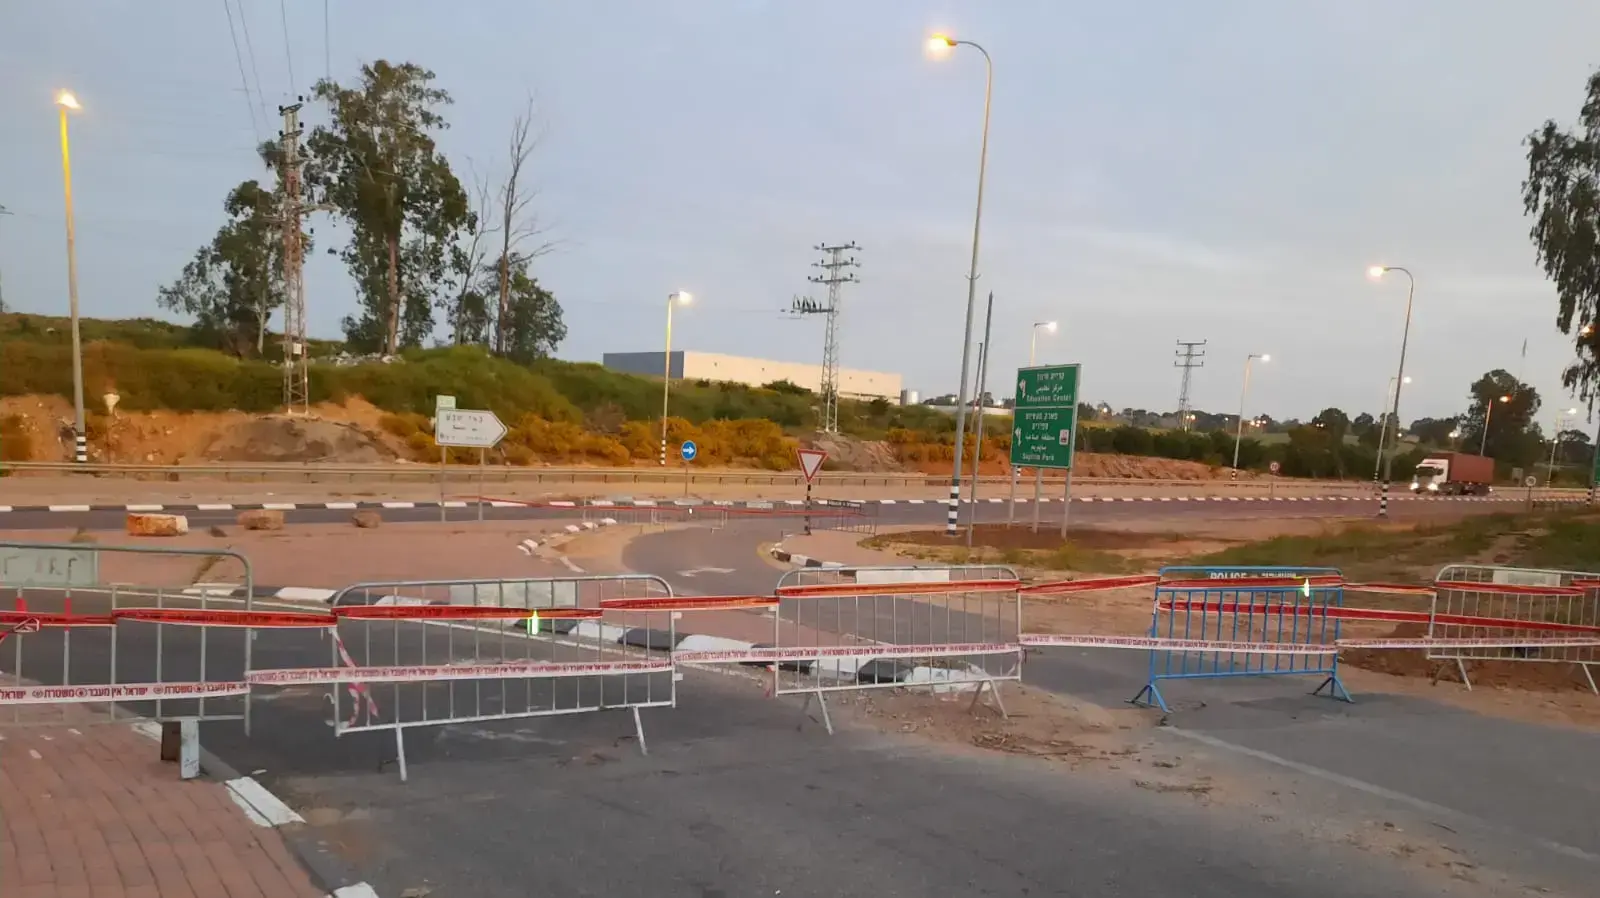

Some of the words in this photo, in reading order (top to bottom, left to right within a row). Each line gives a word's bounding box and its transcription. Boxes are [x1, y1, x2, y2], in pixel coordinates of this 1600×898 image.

[1026, 394, 1051, 402] Education
[1053, 394, 1072, 402] Center
[1210, 572, 1247, 580] POLICE
[44, 688, 74, 698] משטרת
[88, 687, 110, 698] מעבר
[111, 687, 122, 699] אין
